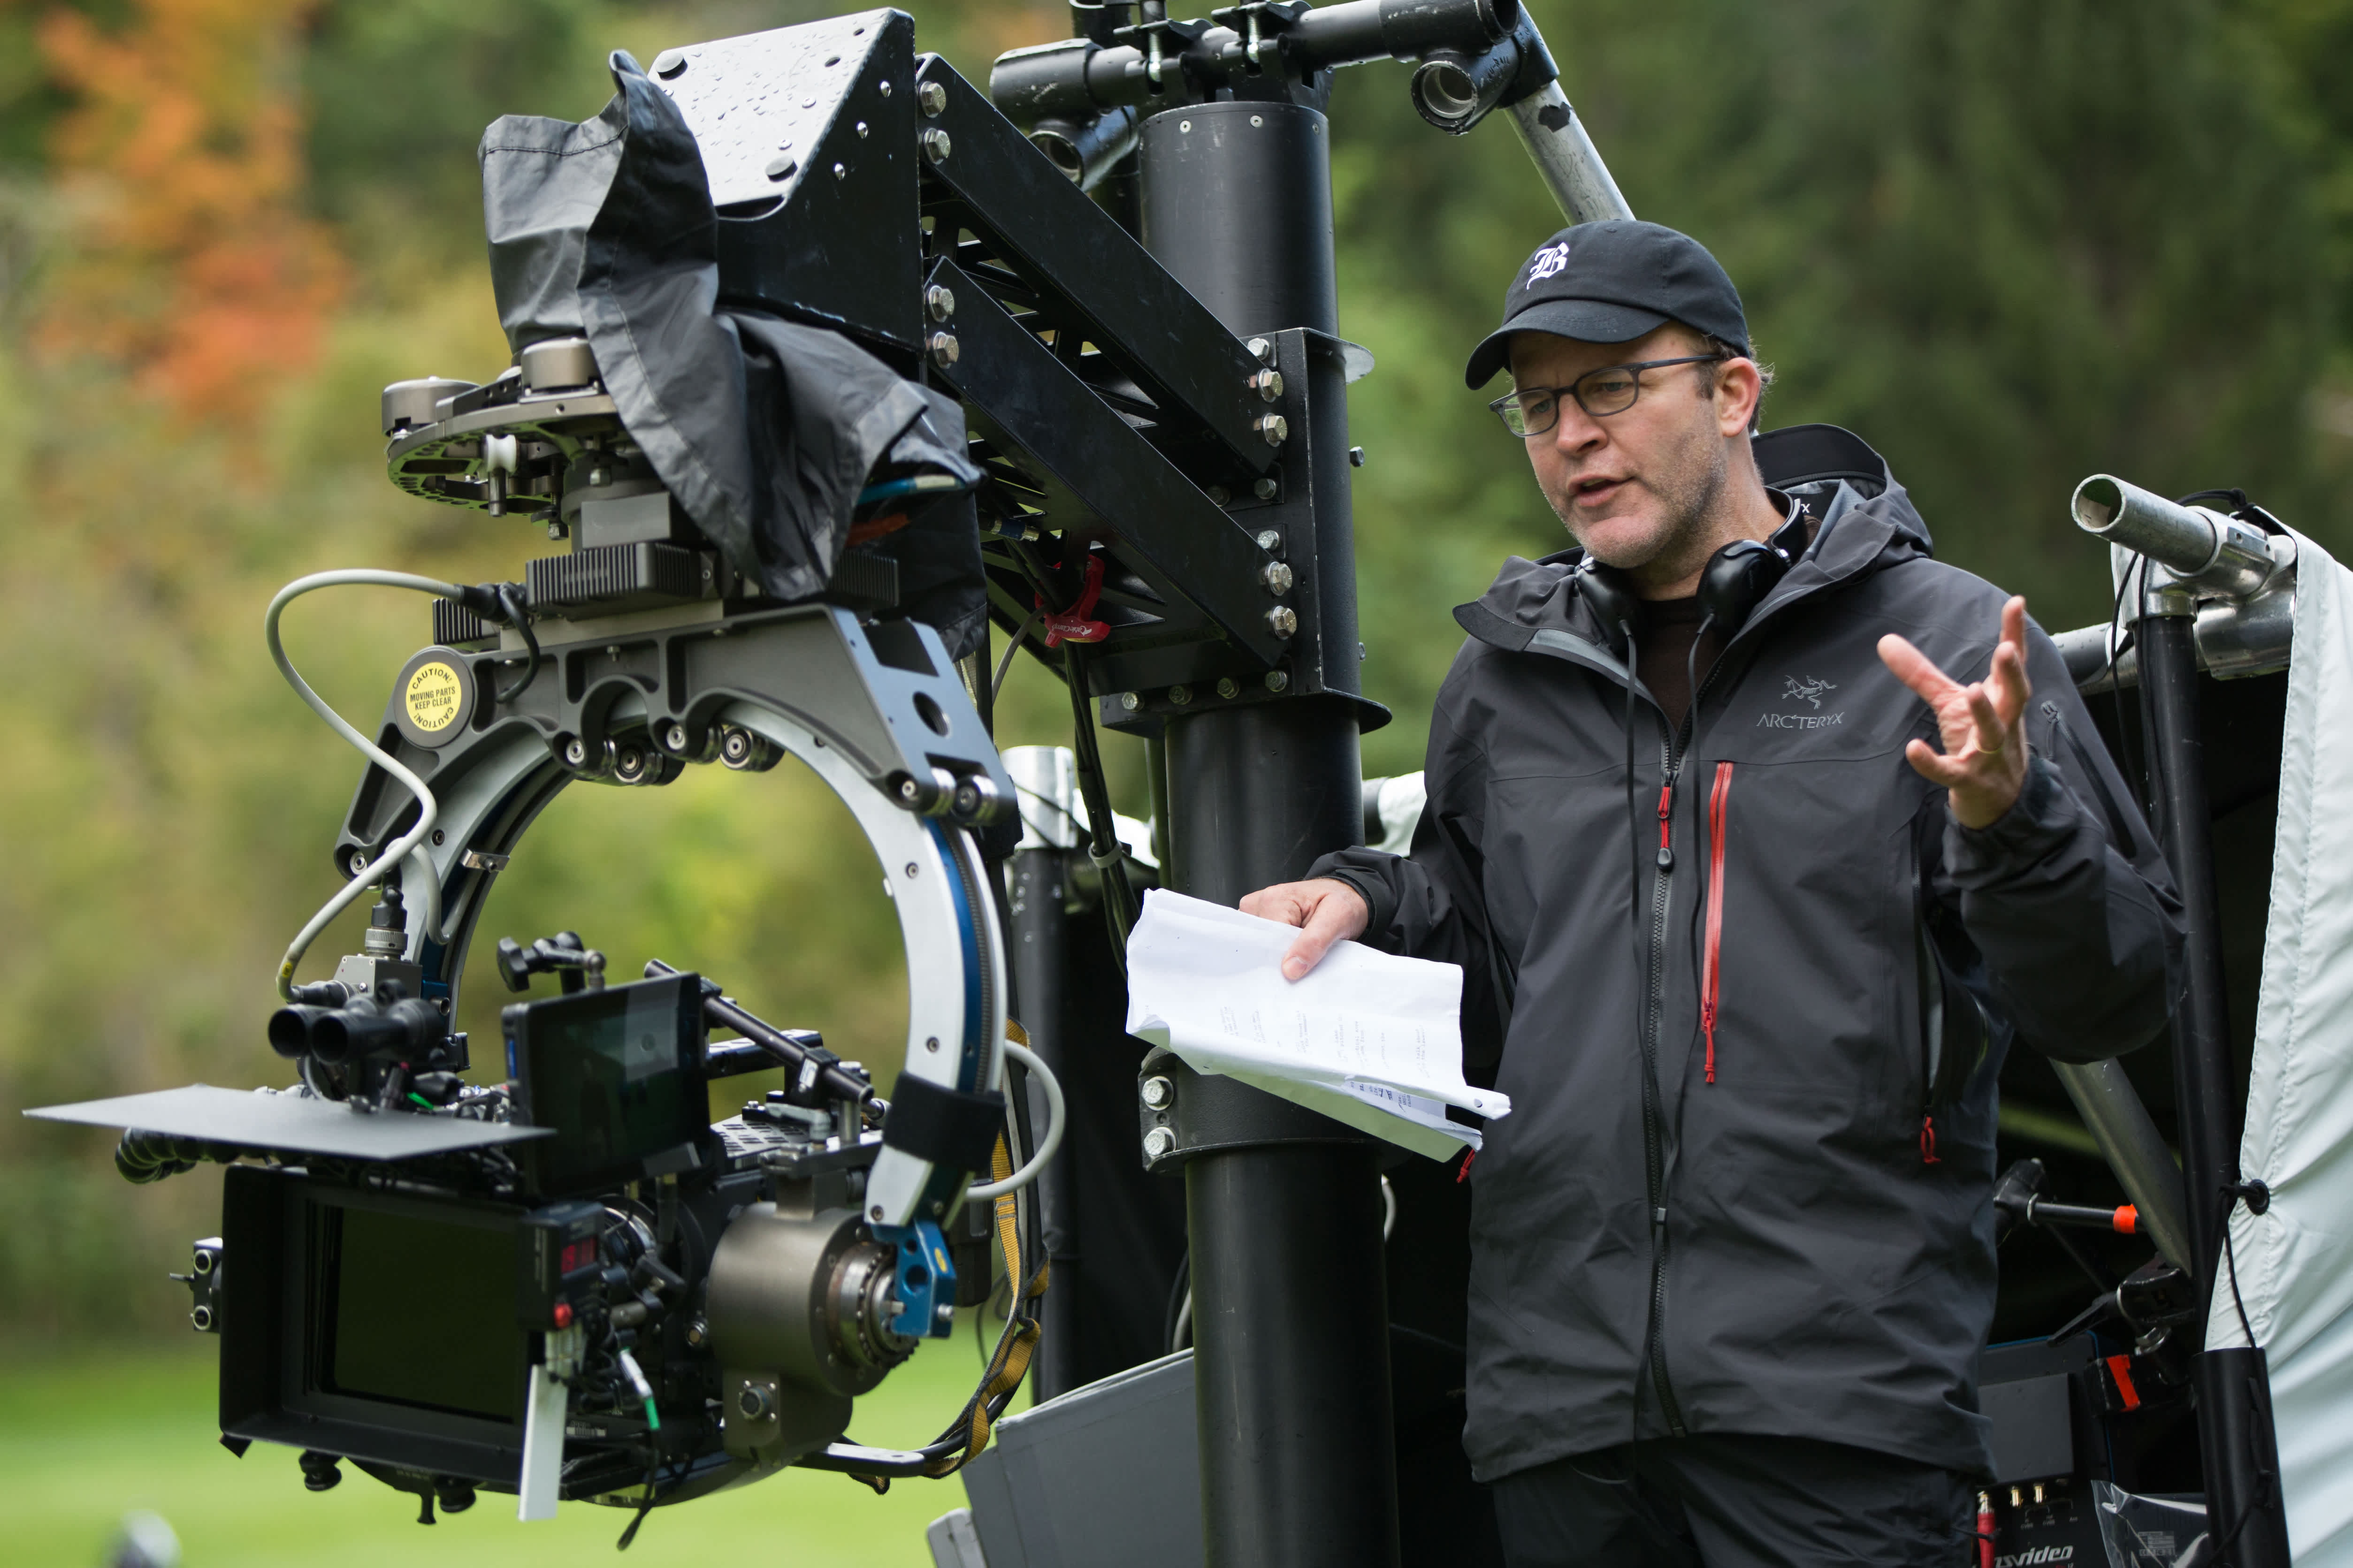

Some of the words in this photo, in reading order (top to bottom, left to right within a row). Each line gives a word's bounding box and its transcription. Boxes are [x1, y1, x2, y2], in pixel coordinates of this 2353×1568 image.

[1527, 242, 1569, 290] B
[413, 668, 452, 689] CAUTION!
[410, 691, 434, 702] MOVING
[436, 686, 455, 696] PARTS
[415, 700, 430, 710] KEEP
[432, 696, 451, 707] CLEAR
[413, 707, 454, 728] CAUTION!
